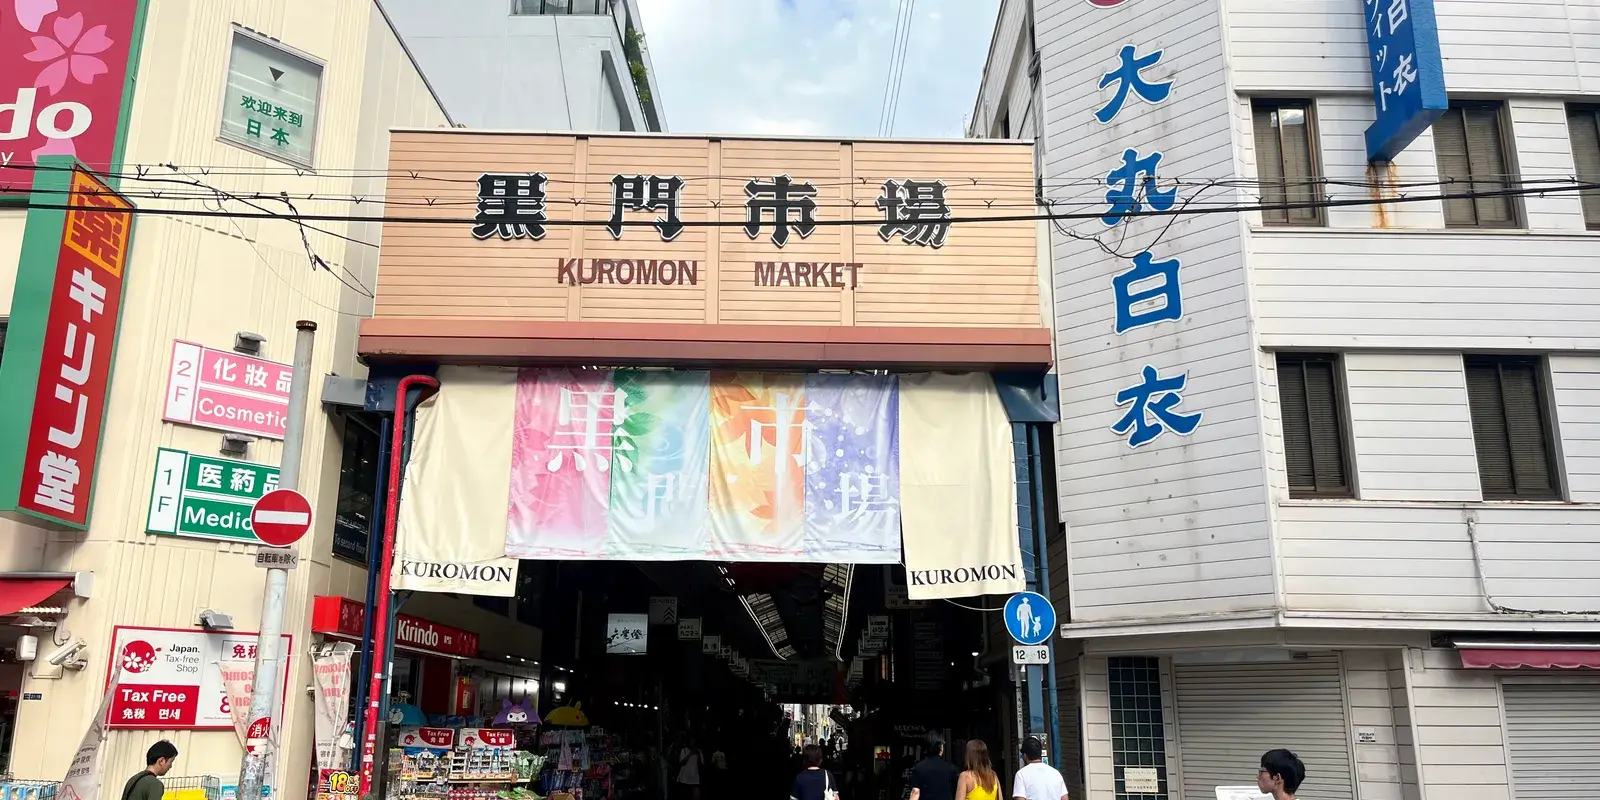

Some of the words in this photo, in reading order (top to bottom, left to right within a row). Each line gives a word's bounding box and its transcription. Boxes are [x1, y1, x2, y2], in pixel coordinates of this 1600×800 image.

[240, 95, 304, 128] 欢迎来到
[246, 118, 290, 147] 日本
[471, 171, 953, 249] 黒門市場
[1094, 43, 1203, 449] 大丸白衣
[557, 257, 698, 286] KUROMON
[754, 261, 864, 288] MARKET
[33, 266, 108, 515] キリン堂
[257, 552, 297, 565] 自転車を除く
[400, 558, 513, 583] KUROMON
[911, 564, 1017, 586] KUROMON
[397, 619, 439, 647] Kirindo
[164, 654, 200, 665] Tax-free
[169, 643, 200, 654] Japan.
[1015, 650, 1026, 660] 12
[1037, 650, 1047, 660] 18
[175, 663, 199, 674] Shop
[121, 689, 150, 702] Tax
[152, 689, 187, 703] Free
[122, 707, 145, 720] 免税
[158, 708, 181, 720] 면세
